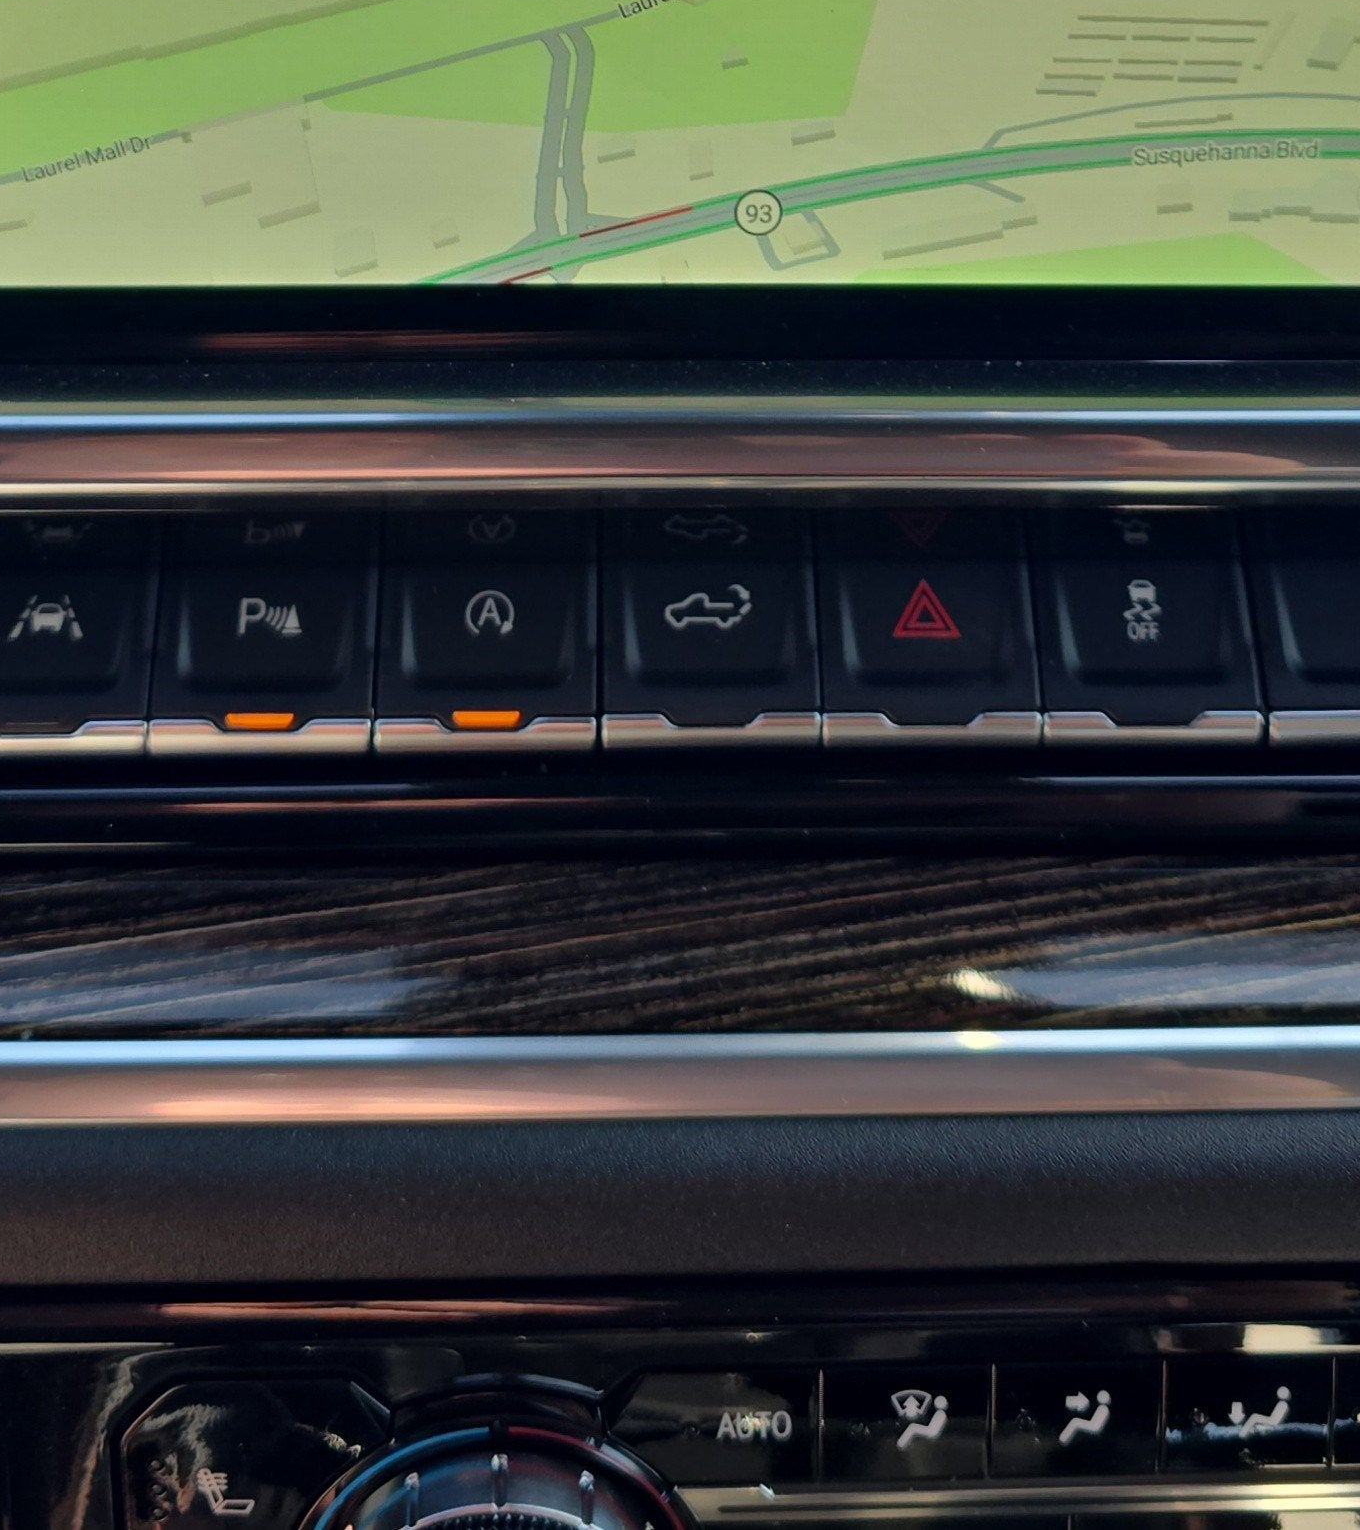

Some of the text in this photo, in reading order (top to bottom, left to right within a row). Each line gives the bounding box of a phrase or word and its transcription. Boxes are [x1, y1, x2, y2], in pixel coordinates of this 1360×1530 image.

[22, 135, 153, 183] Laurel Mall Dr
[1133, 140, 1321, 168] Susquehanna Blvd
[744, 203, 774, 225] 93
[1126, 622, 1161, 642] OFF
[715, 1409, 793, 1441] AUTO
